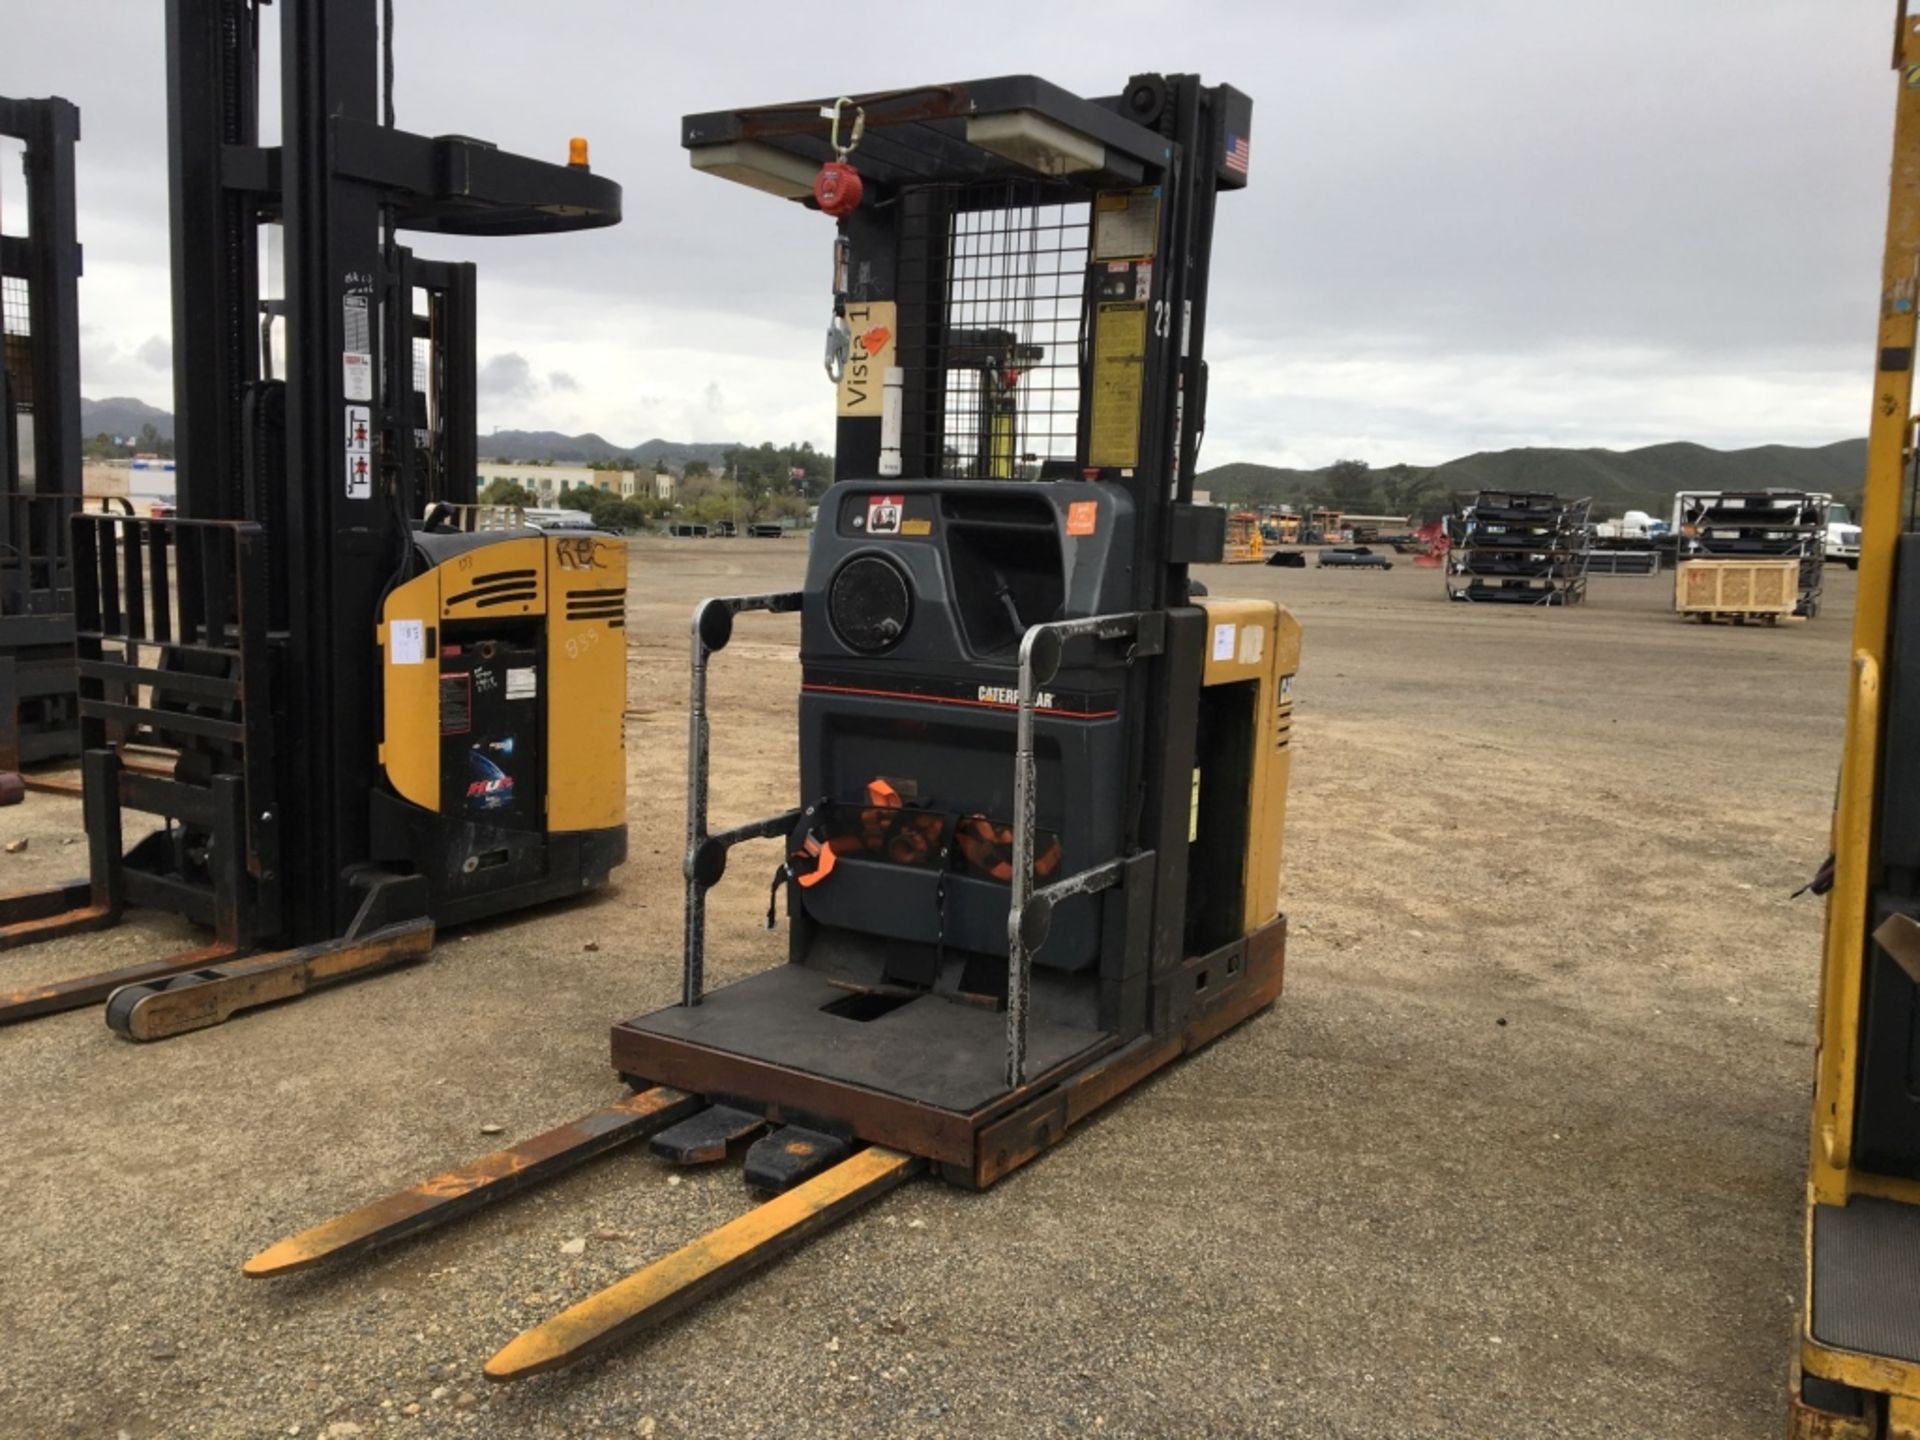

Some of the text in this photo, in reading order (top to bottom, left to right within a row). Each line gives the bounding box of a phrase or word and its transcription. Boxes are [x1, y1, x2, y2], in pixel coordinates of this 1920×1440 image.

[847, 307, 870, 407] Vista 1
[978, 685, 1053, 708] CATERPAR
